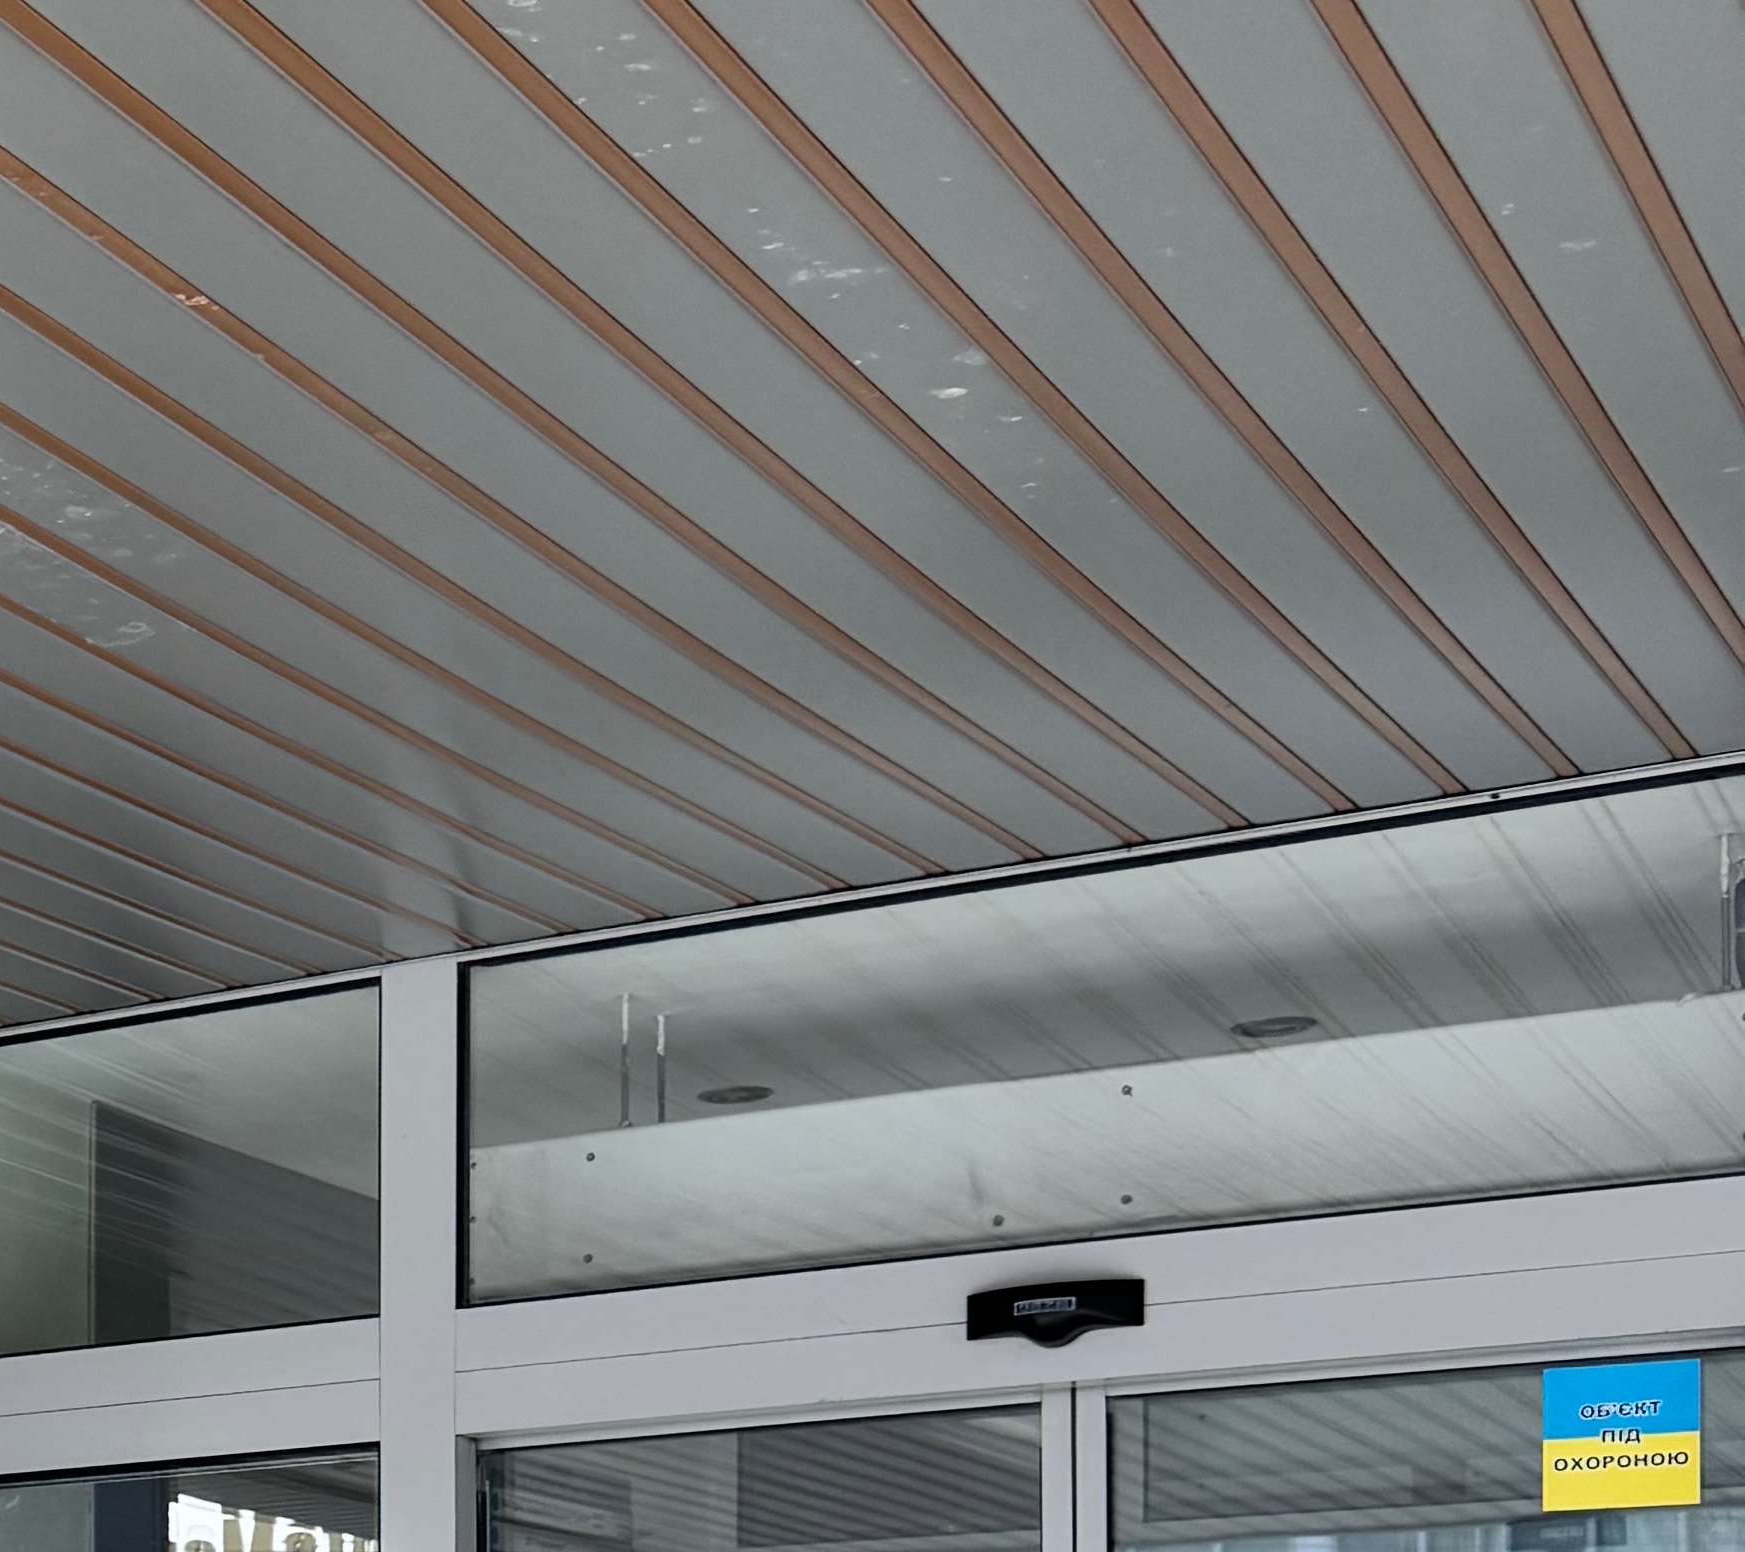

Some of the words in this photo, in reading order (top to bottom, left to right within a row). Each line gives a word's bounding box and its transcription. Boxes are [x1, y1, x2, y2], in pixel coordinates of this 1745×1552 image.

[1580, 1400, 1662, 1420] ОБ'ЄКТ
[1601, 1427, 1642, 1445] ПІД
[1553, 1450, 1690, 1472] ОХОРОНОЮ
